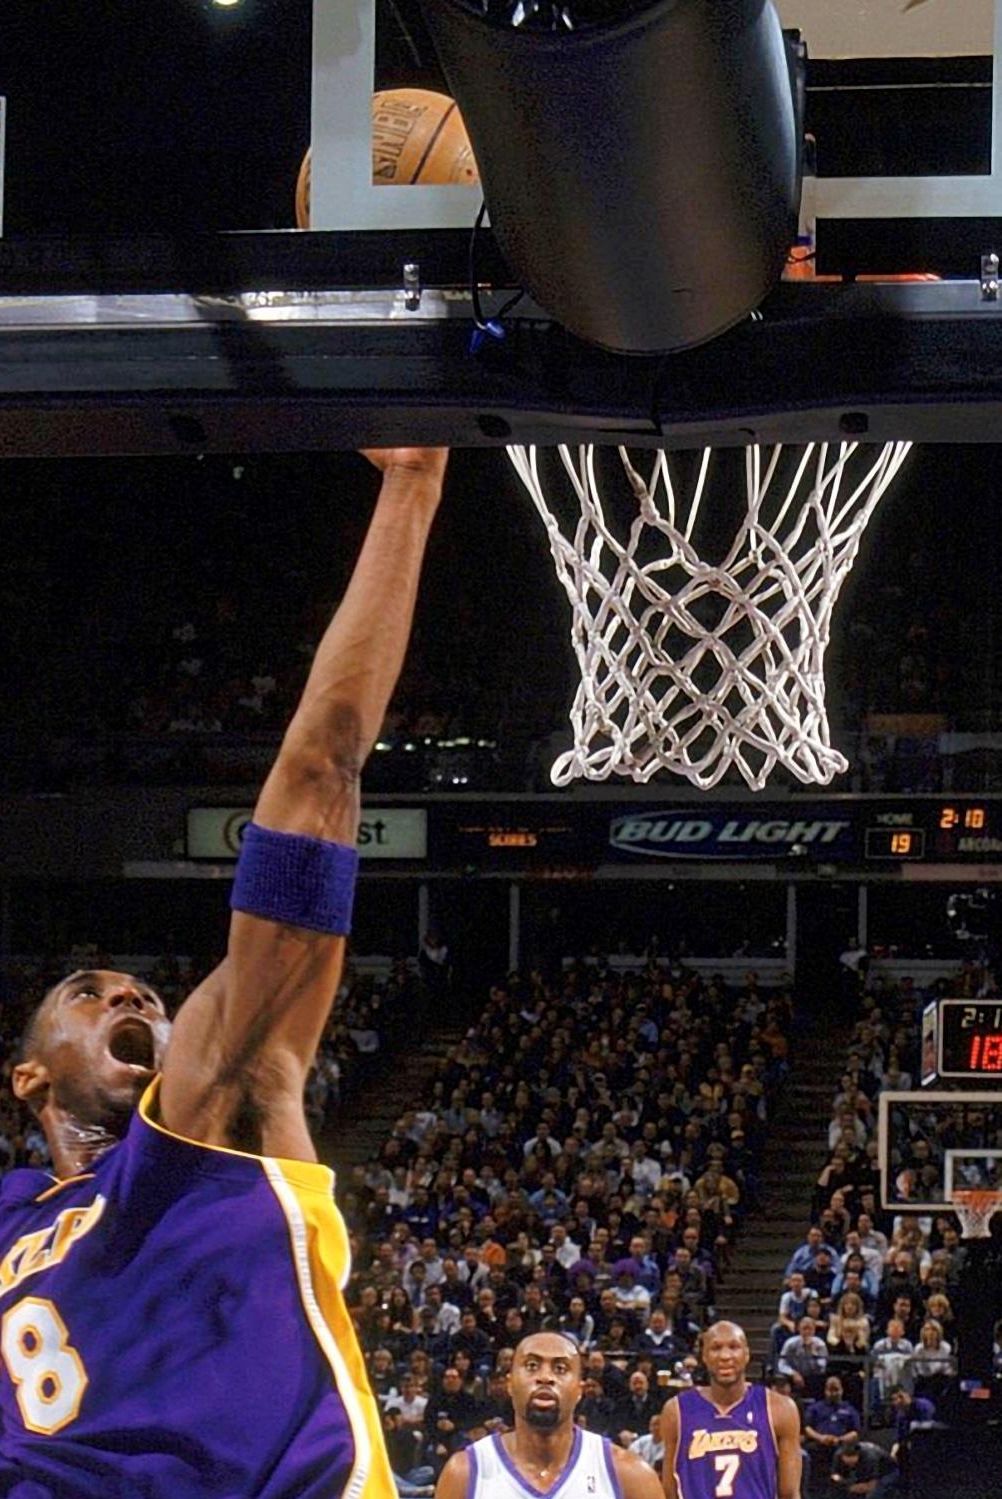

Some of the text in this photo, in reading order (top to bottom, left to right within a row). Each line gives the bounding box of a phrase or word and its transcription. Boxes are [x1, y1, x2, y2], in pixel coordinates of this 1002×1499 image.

[615, 820, 852, 843] BUD LIGHT
[890, 833, 912, 854] 19
[0, 1296, 89, 1436] 8
[714, 1454, 741, 1498] 7
